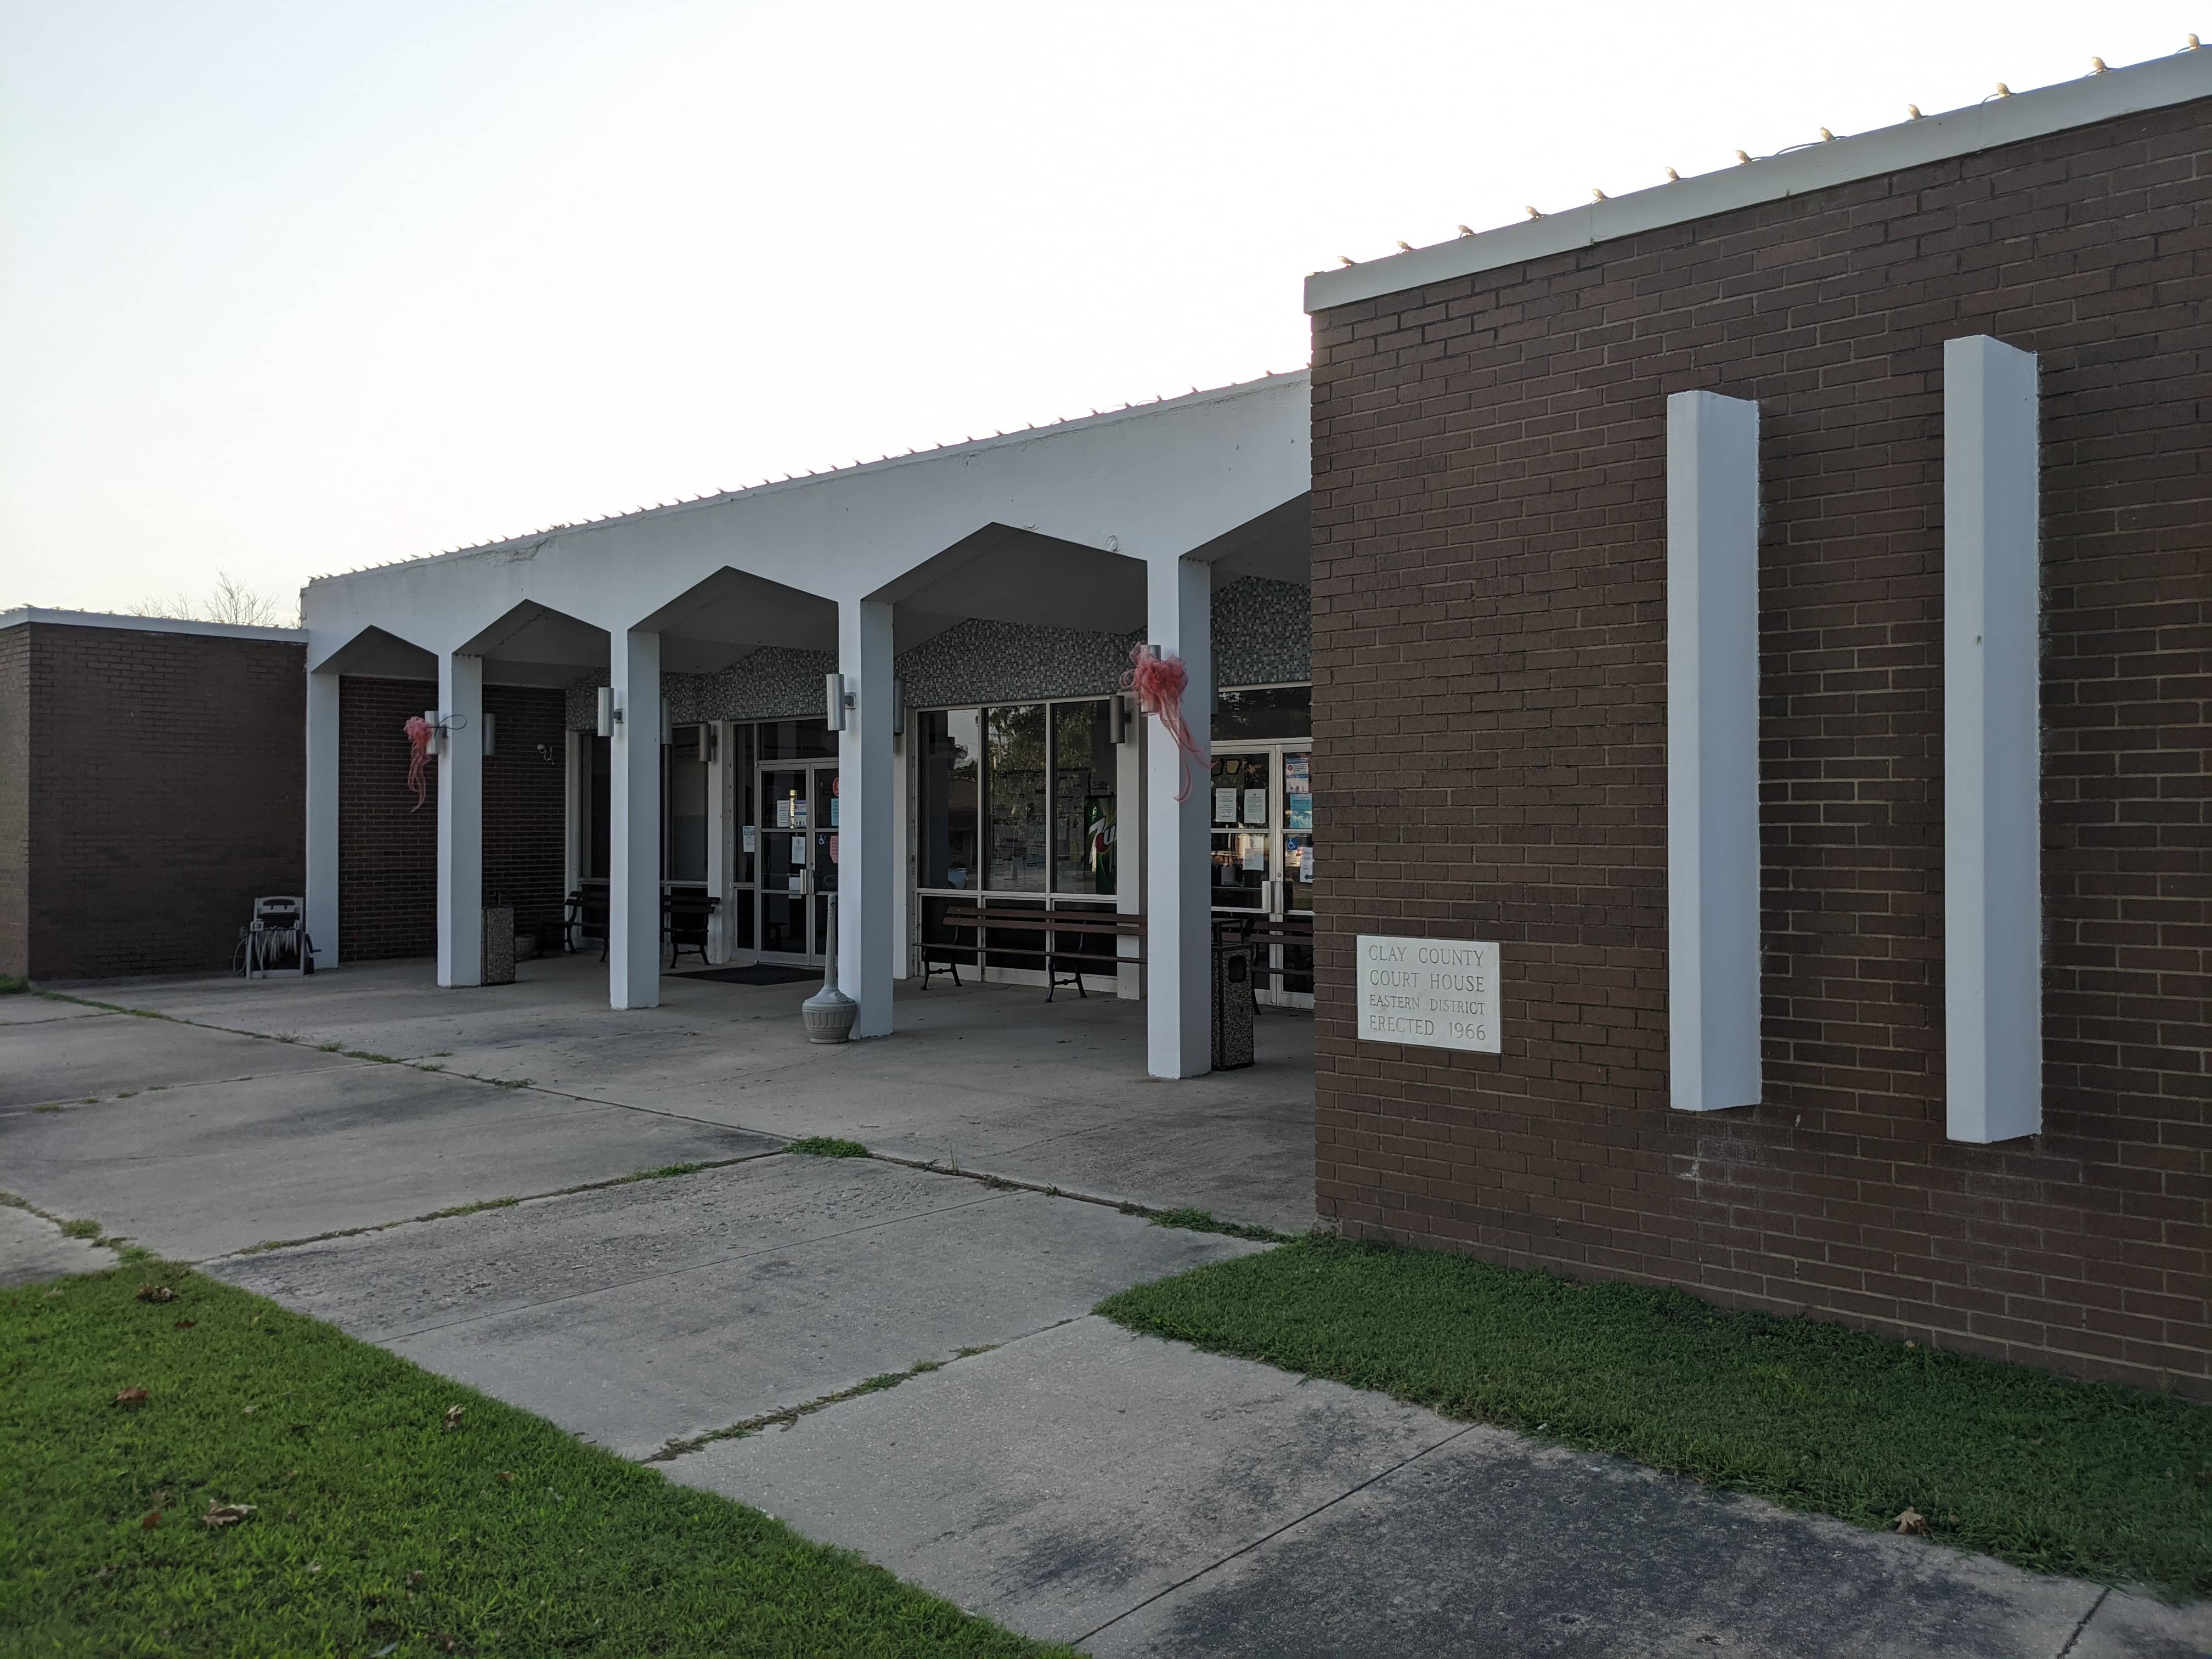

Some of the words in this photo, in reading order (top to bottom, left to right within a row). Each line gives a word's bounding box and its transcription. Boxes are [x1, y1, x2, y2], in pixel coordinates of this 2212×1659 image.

[1369, 945, 1407, 961] CLAY
[1419, 947, 1484, 966] COUNTY
[1370, 970, 1420, 988] COURT
[1430, 974, 1485, 992] HOUSE
[1369, 994, 1420, 1009] EASTERN
[1430, 998, 1485, 1014] DISTRICT
[1369, 1015, 1435, 1035] ERECTED
[1449, 1022, 1486, 1041] 1966
